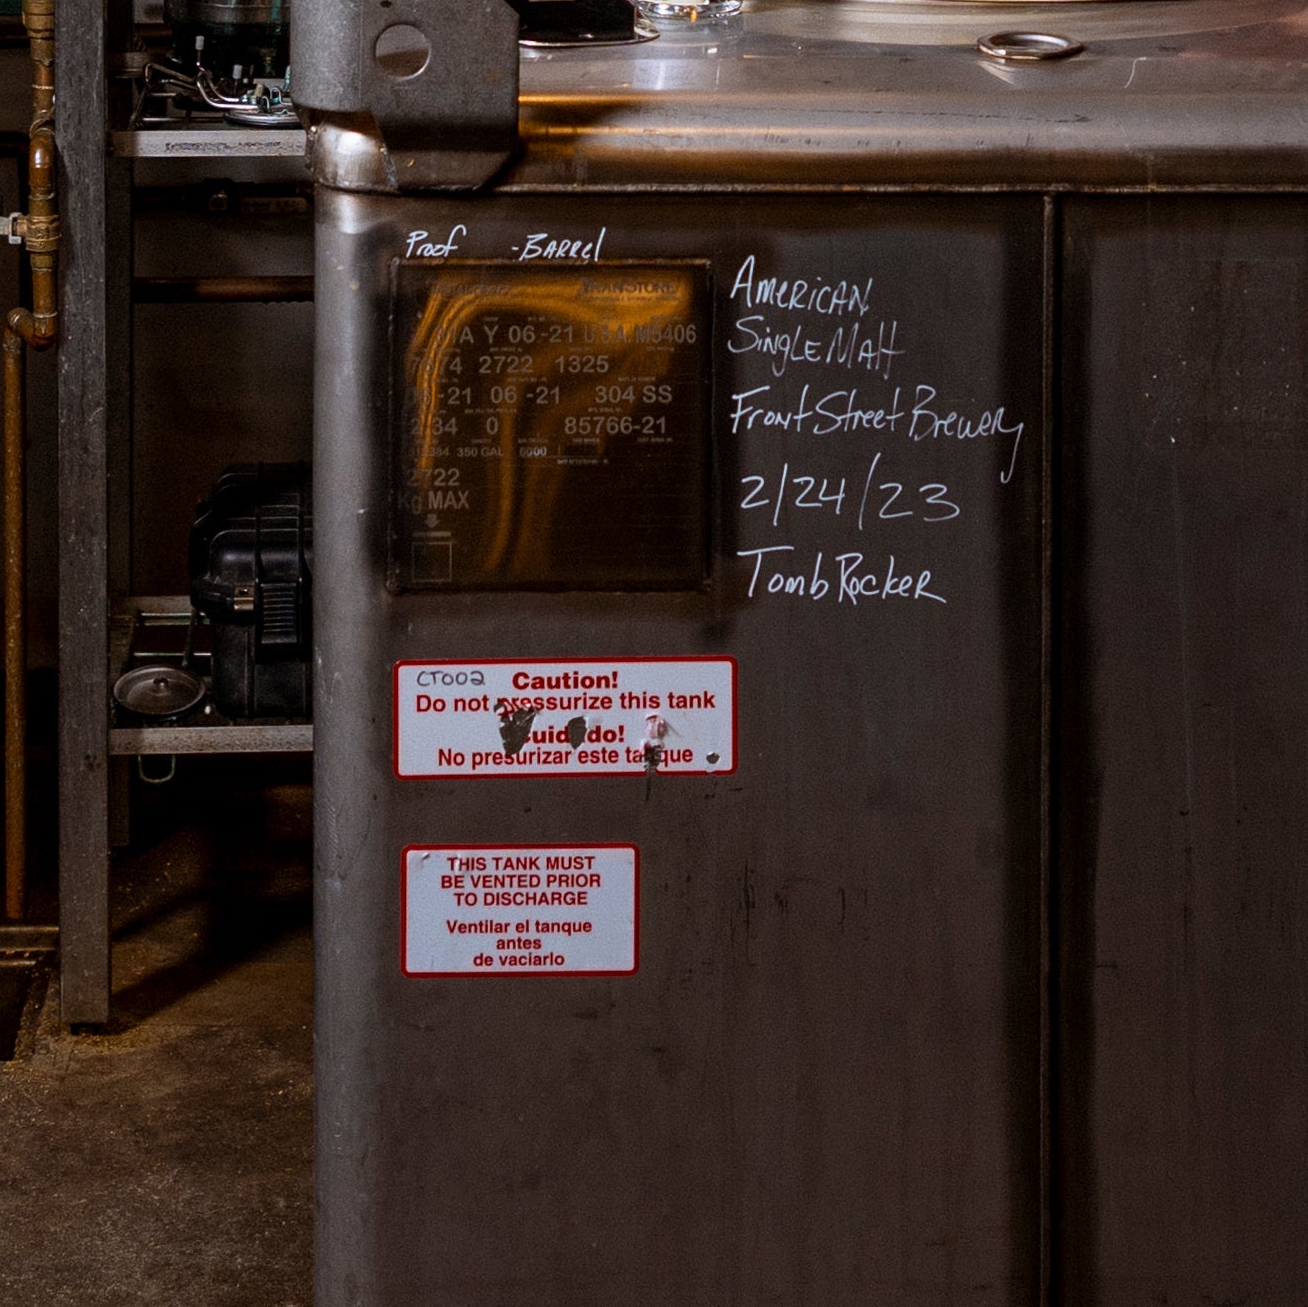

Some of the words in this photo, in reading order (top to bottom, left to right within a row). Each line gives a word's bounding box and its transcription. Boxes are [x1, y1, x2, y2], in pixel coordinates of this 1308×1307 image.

[406, 224, 467, 258] Proof
[484, 325, 499, 345] Y
[508, 325, 536, 345] 06
[478, 355, 534, 375] 2722
[555, 354, 610, 374] 1325
[490, 385, 518, 405] 06
[595, 385, 636, 405] 304
[642, 384, 673, 404] SS
[564, 415, 667, 435] 85766-21
[730, 384, 814, 434] Front
[813, 387, 905, 435] Street
[908, 385, 1025, 484] Brewery
[405, 467, 461, 486] 2722
[427, 489, 470, 510] MAX
[741, 451, 961, 531] 2/24/23
[736, 545, 829, 601] Tomb
[511, 670, 619, 691] Caution!
[415, 694, 446, 714] Do
[453, 693, 490, 713] not
[619, 690, 661, 710] this
[667, 690, 716, 709] tank
[512, 725, 625, 744] uiddo!
[437, 747, 465, 767] No
[471, 746, 572, 770] presurizar
[577, 747, 620, 764] este
[625, 747, 694, 768] taque
[447, 856, 487, 872] THIS
[492, 856, 541, 871] TANK
[546, 855, 596, 870] MUST
[441, 875, 465, 889] BE
[470, 874, 542, 889] VENTED
[546, 873, 601, 888] PRIOR
[454, 892, 478, 907] TO
[483, 891, 588, 906] DISCHARGE
[446, 919, 511, 934] Ventilar
[515, 919, 530, 934] el
[535, 919, 593, 937] tanque
[496, 937, 542, 951] antes
[473, 953, 494, 967] de
[499, 952, 565, 967] vaciarlo
